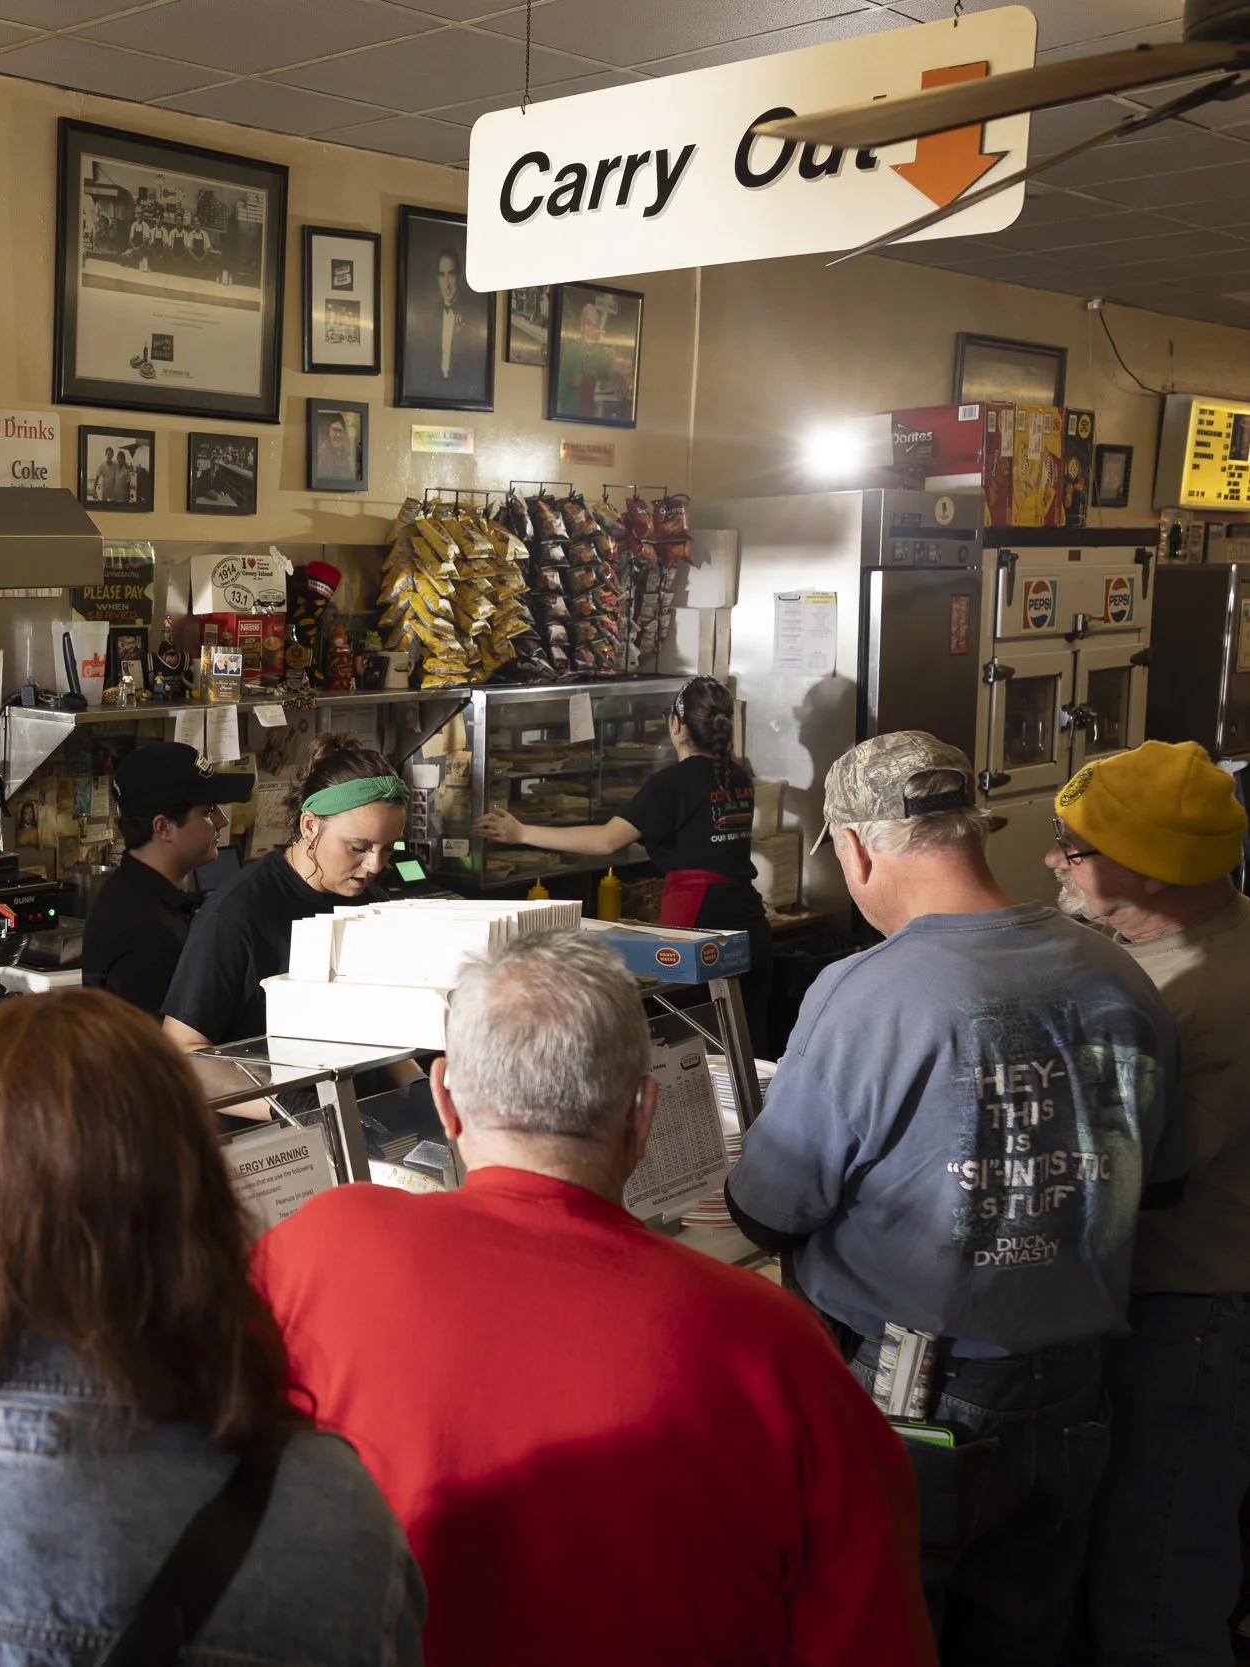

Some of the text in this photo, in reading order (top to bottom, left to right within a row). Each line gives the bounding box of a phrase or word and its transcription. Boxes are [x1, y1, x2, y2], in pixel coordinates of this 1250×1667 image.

[499, 143, 697, 223] Carry
[4, 417, 55, 440] Drinks
[11, 460, 48, 480] Coke
[218, 563, 237, 581] 1914
[83, 585, 144, 600] PLEASE PAY
[231, 590, 248, 606] 13.1
[1109, 594, 1131, 607] PEPSI
[96, 603, 129, 611] WHEN
[1028, 597, 1052, 611] PEPSI
[85, 611, 138, 620] SERVED
[14, 896, 35, 905] BUNN
[986, 1099, 1054, 1129] THIS
[1005, 1134, 1032, 1154] IS
[266, 1145, 309, 1167] WARNING
[980, 1185, 1076, 1220] STUFF
[279, 1211, 289, 1219] Tree
[996, 1234, 1047, 1252] DUCK
[974, 1239, 1060, 1267] DYNASTY
